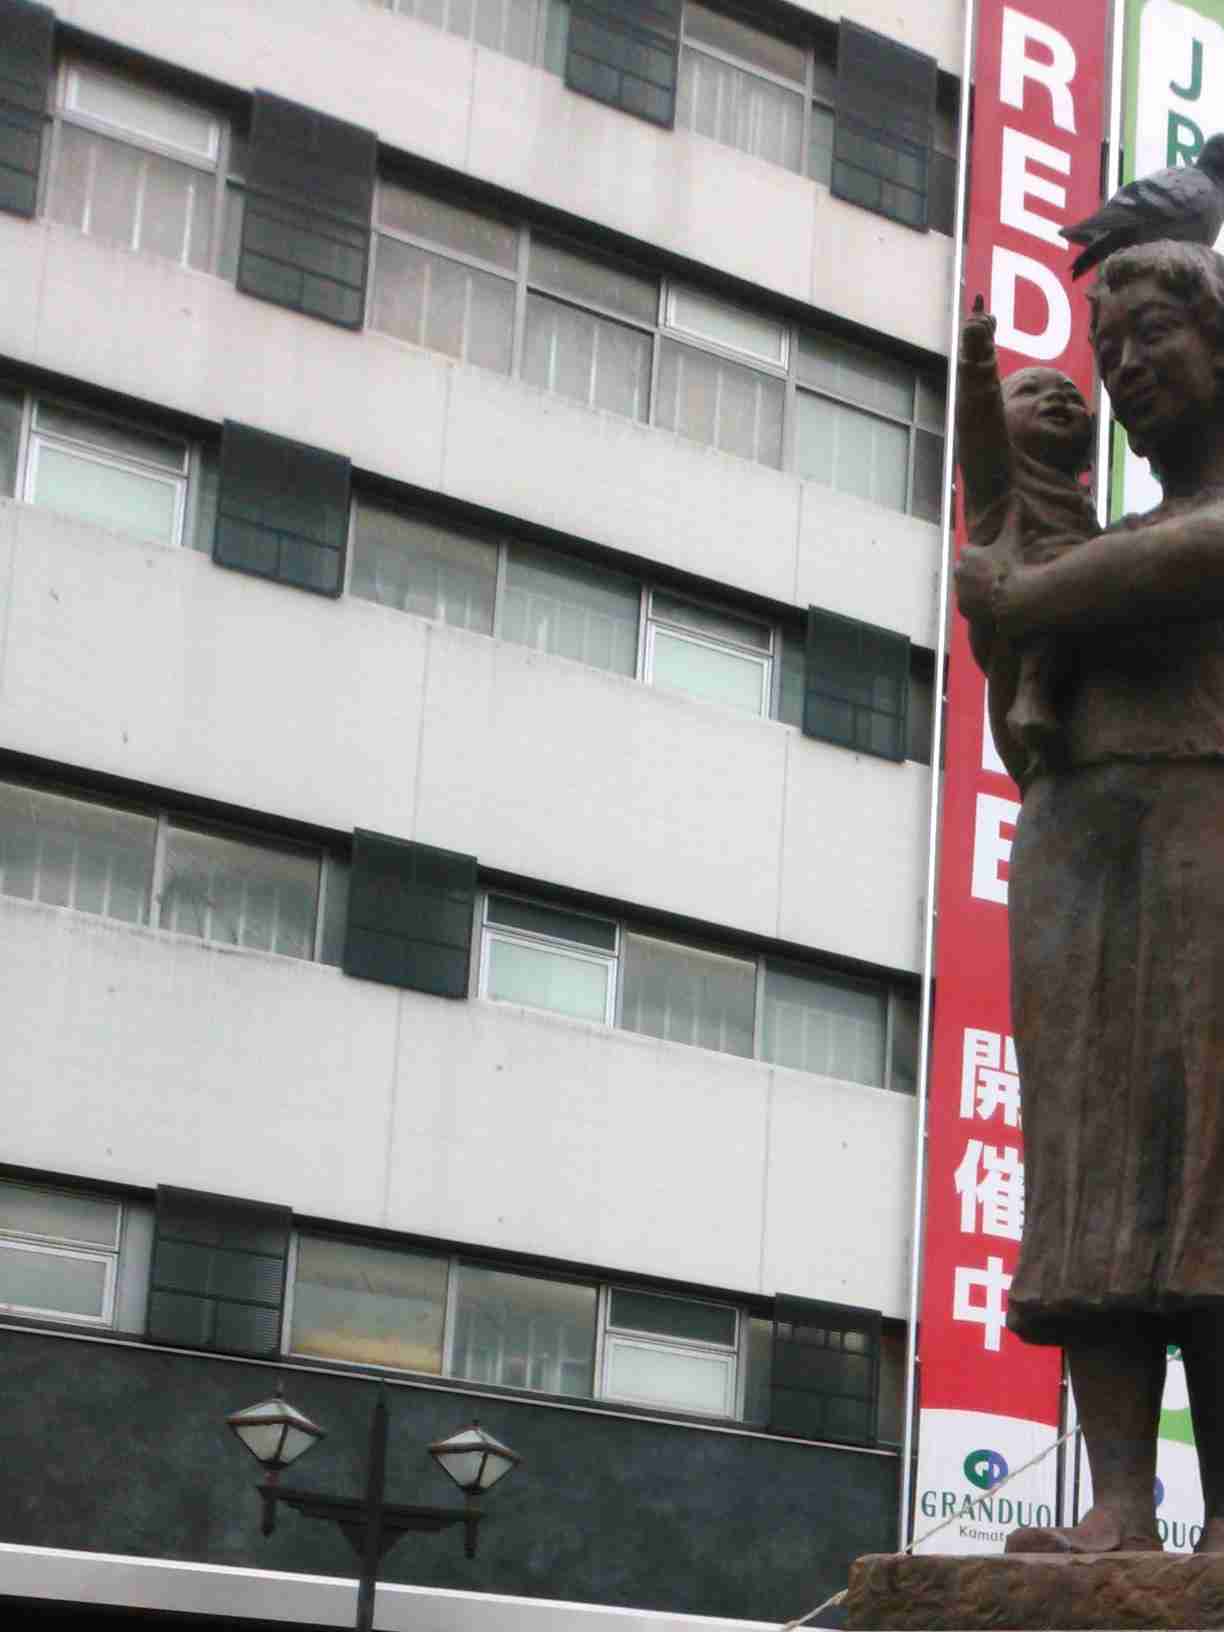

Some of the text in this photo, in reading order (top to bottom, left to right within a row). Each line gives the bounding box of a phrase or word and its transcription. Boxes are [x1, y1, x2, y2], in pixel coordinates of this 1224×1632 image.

[991, 6, 1077, 361] RED
[951, 1027, 1025, 1352] 開催中
[921, 1490, 1052, 1528] GRANDUO
